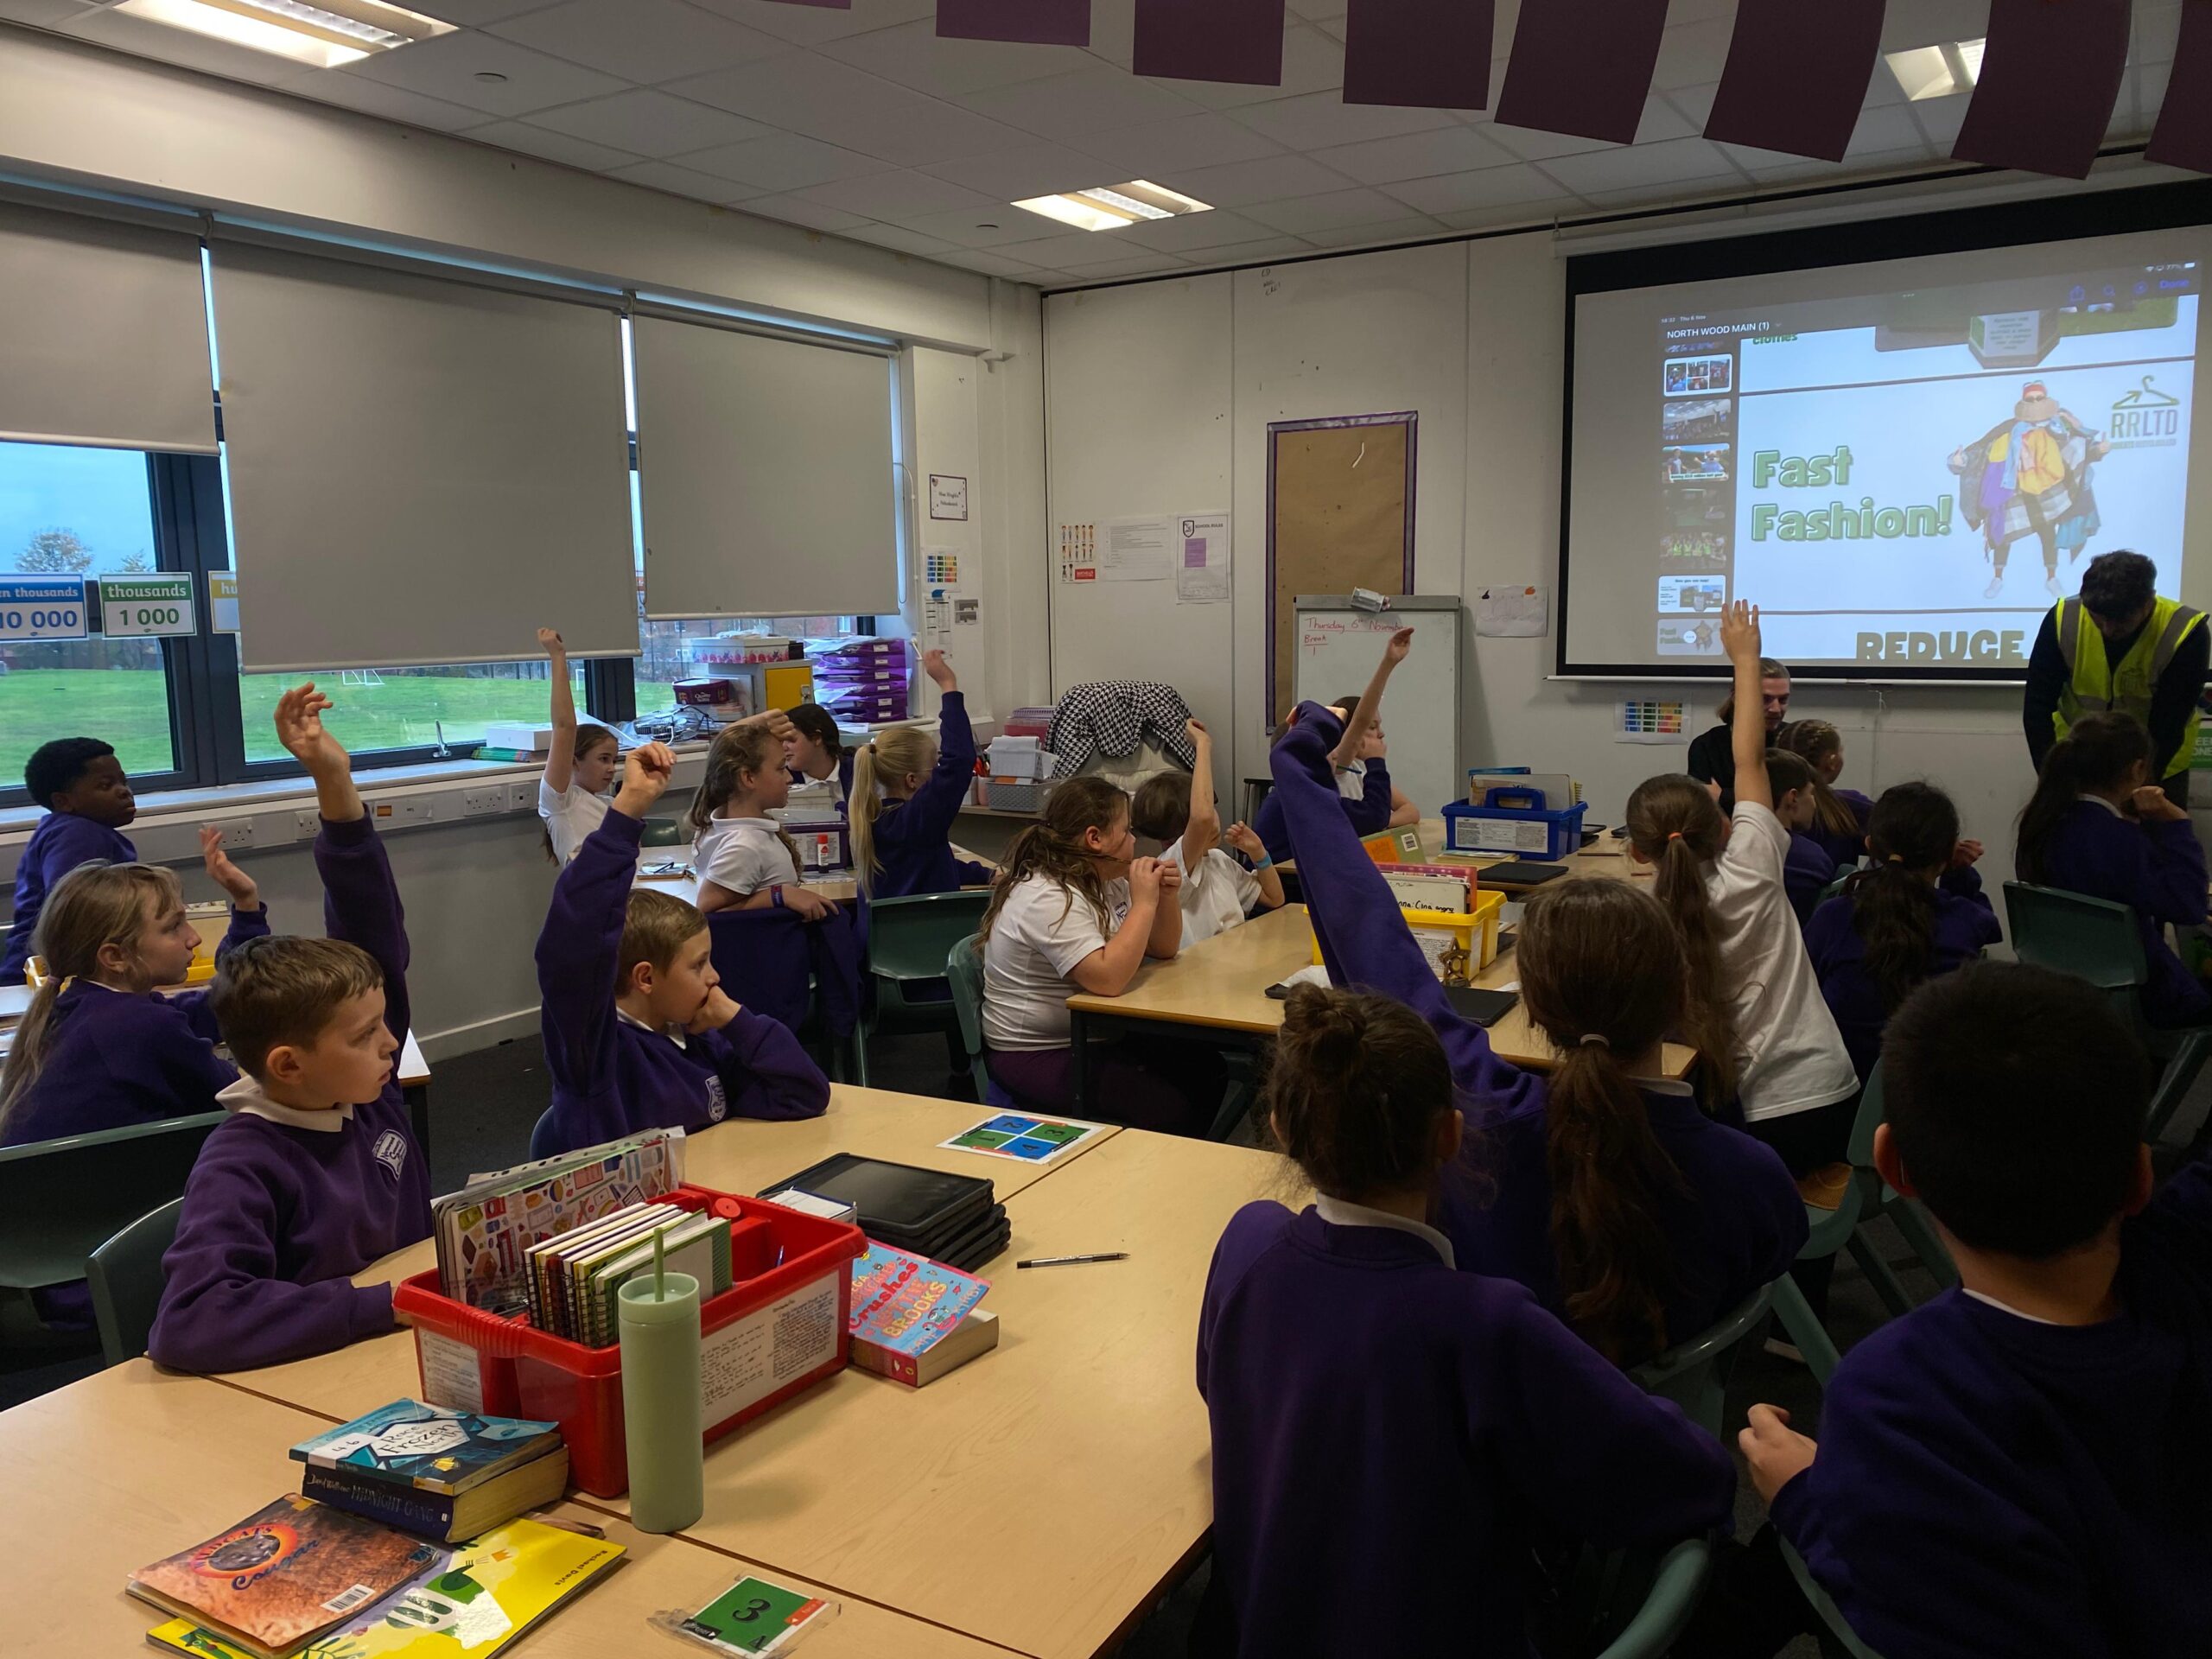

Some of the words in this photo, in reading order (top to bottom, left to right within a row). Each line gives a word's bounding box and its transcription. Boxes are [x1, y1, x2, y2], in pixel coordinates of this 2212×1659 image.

[2159, 279, 2190, 289] Done
[1667, 327, 1699, 339] NORTH
[1700, 325, 1730, 336] WOOD
[1732, 322, 1757, 334] MAIN
[1758, 321, 1770, 332] (1)
[2111, 410, 2179, 439] RRLTD
[1752, 445, 1853, 488] Fast
[1751, 494, 1953, 542] Fashion!
[15, 586, 79, 598] thousands
[107, 584, 188, 598] thousands
[30, 609, 79, 628] 000
[118, 608, 129, 626] 1
[137, 607, 181, 626] 000
[1304, 616, 1345, 634] Thursday
[1304, 634, 1326, 644] Break
[1856, 629, 2025, 661] REDUCE
[1022, 1142, 1040, 1152] 4
[849, 1262, 919, 1330] Crushes
[882, 1281, 948, 1339] BROOKS
[378, 1423, 457, 1454] Frozen
[380, 1425, 421, 1445] Race
[414, 1428, 463, 1449] North
[404, 1500, 435, 1522] GANG
[194, 1527, 272, 1570] WILDCATS
[231, 1540, 319, 1591] Cougar
[554, 1569, 579, 1586] Davis
[732, 1599, 771, 1623] 3
